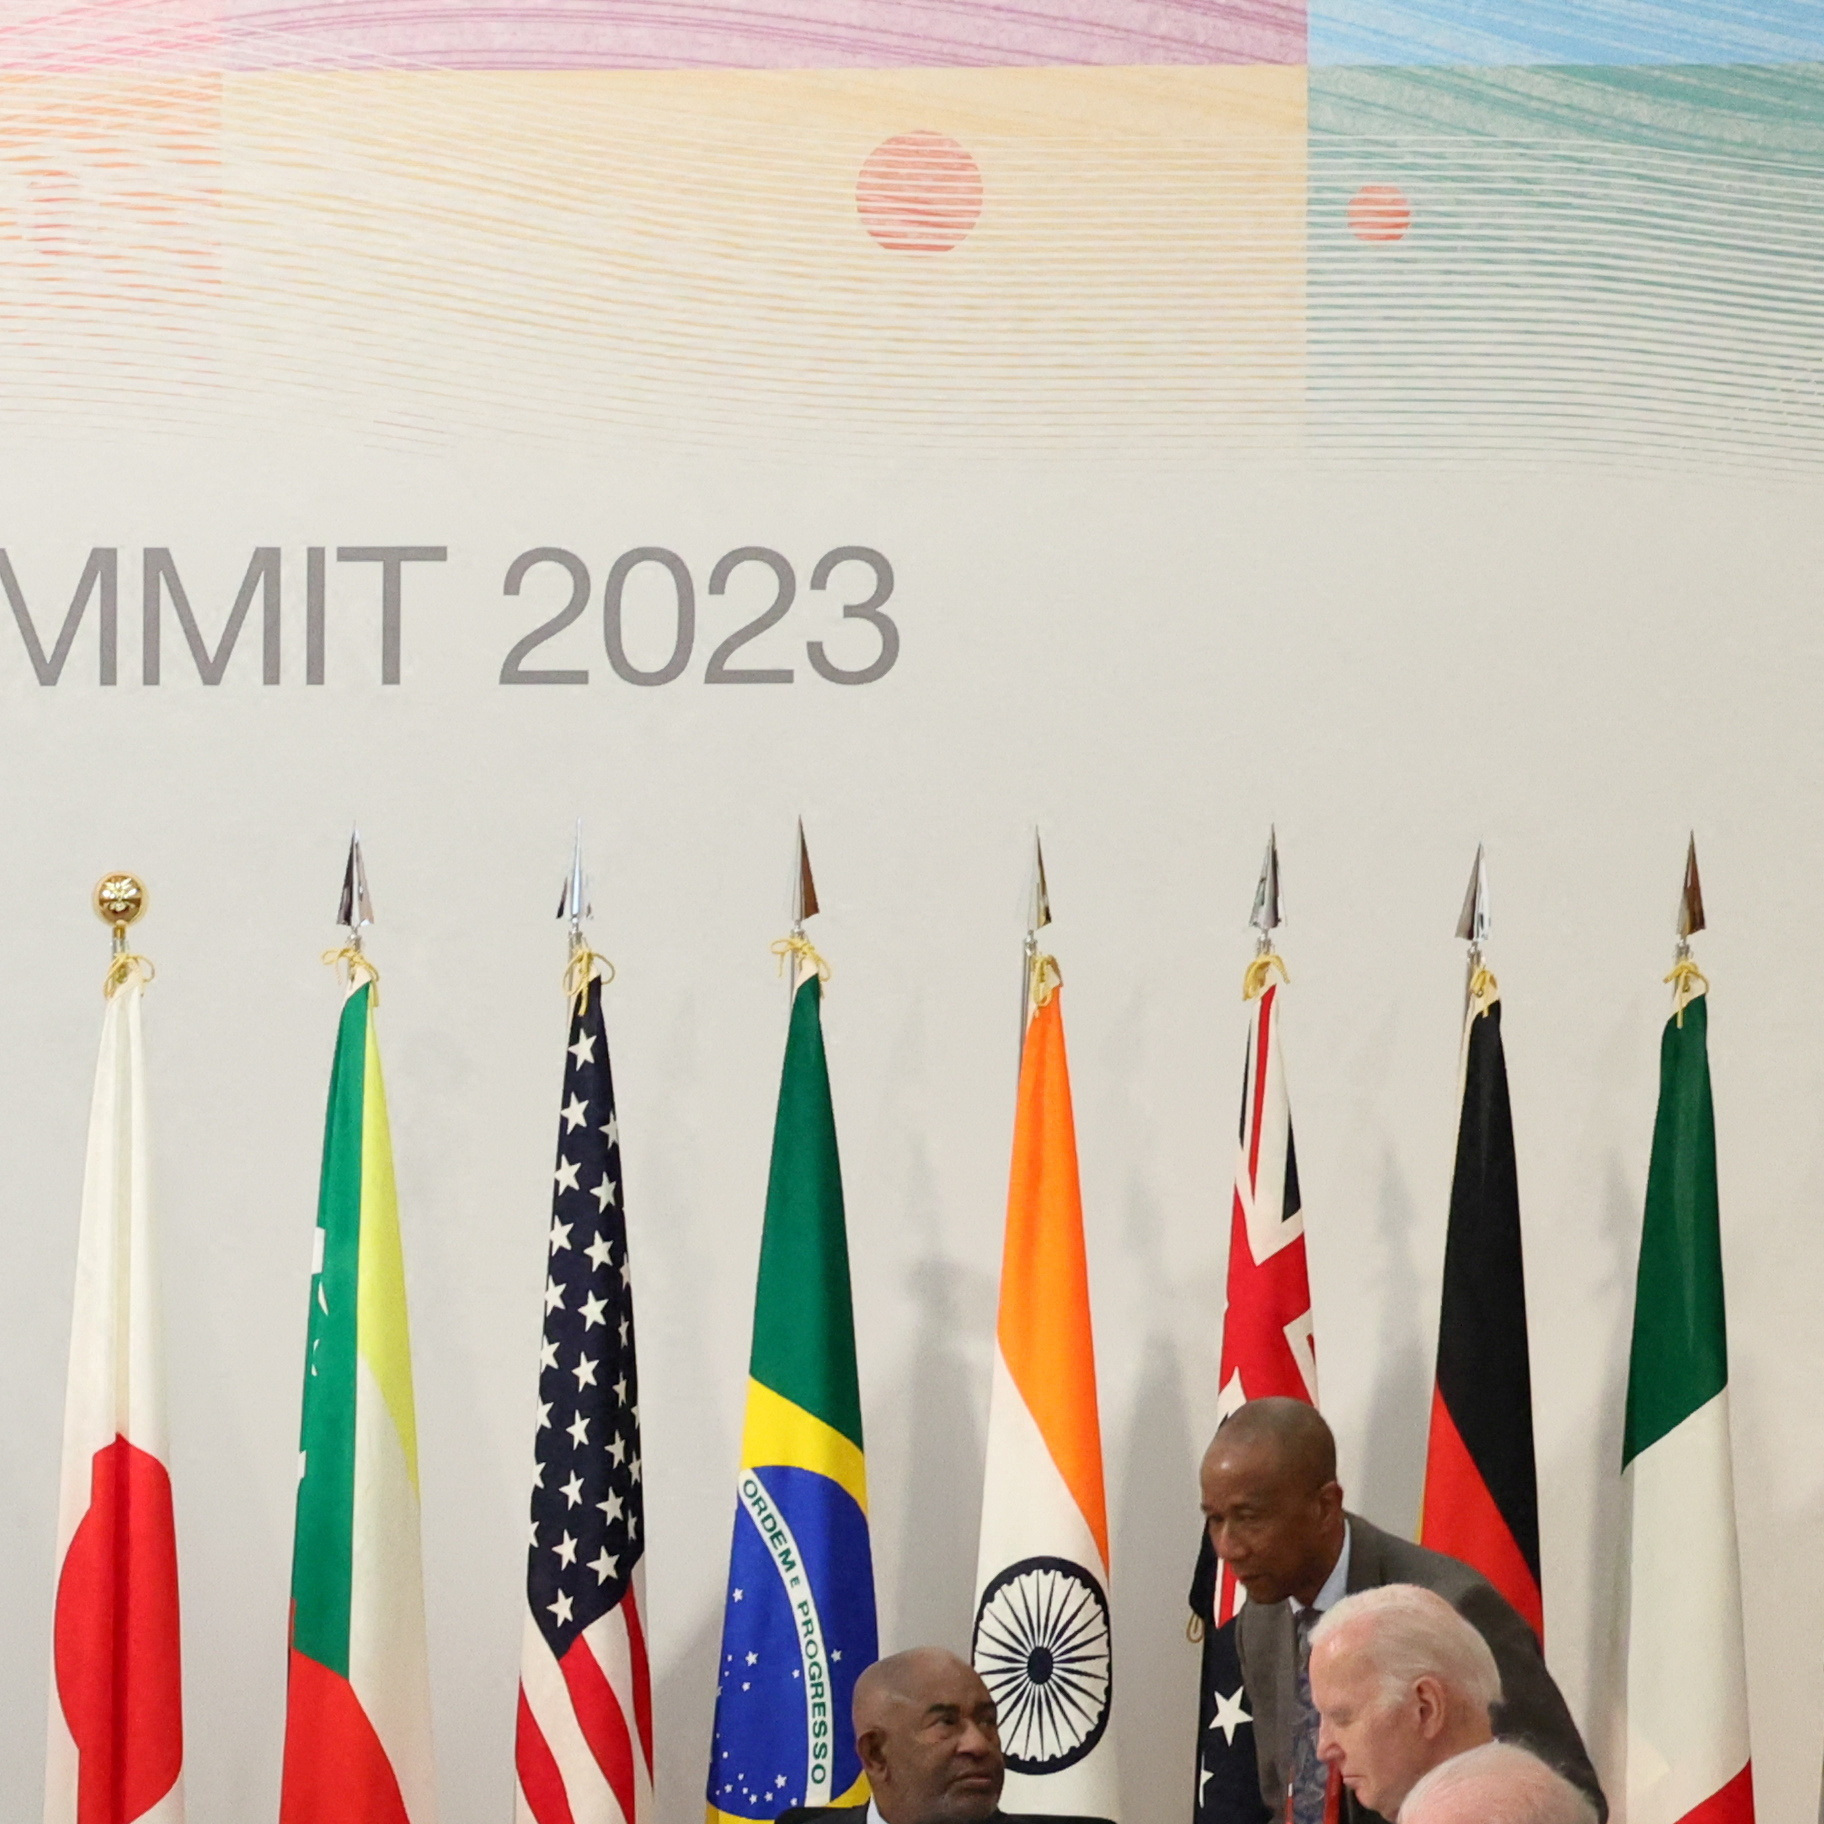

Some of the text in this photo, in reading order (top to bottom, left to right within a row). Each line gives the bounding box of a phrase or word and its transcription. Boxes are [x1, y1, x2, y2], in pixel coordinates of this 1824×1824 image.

[499, 544, 900, 688] 2023
[742, 1478, 830, 1785] ORDEM E PROGRESSO
